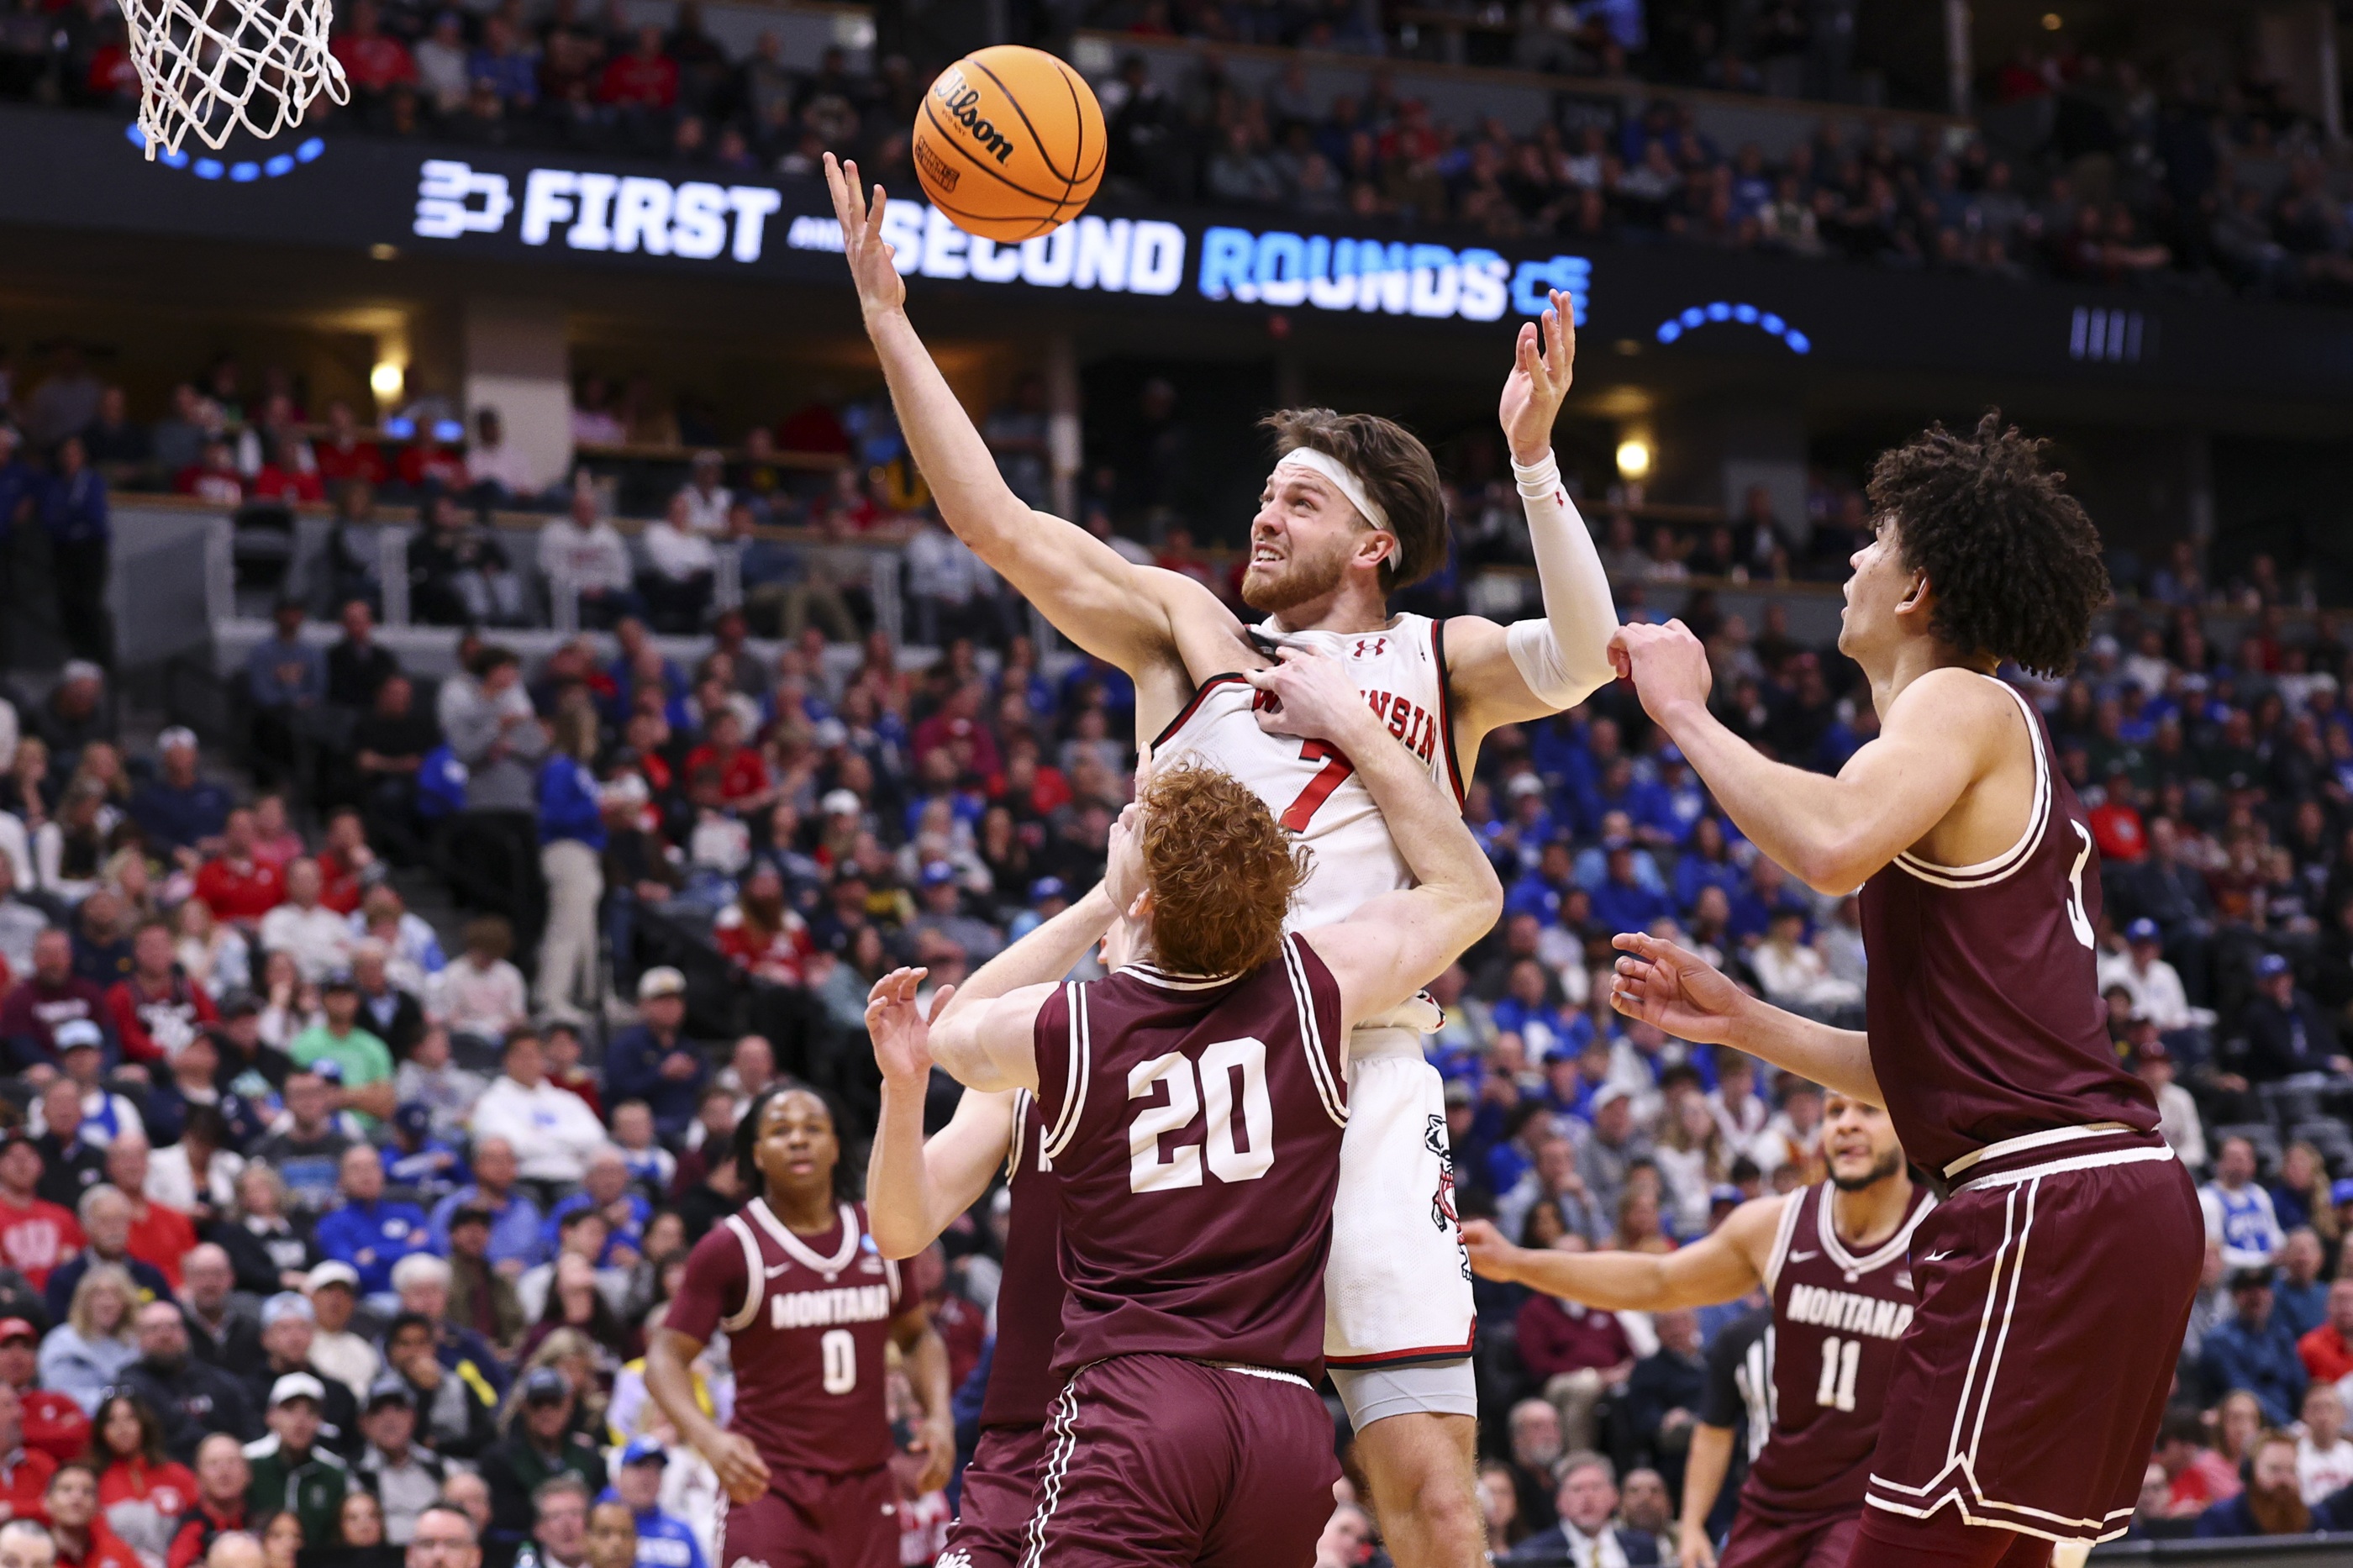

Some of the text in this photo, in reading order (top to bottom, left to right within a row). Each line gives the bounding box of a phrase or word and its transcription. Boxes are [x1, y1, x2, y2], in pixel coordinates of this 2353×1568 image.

[934, 67, 1013, 165] Wilson
[520, 168, 782, 263] FIRST
[879, 197, 1187, 296] SECOND
[1198, 226, 1510, 322] ROUNDS
[1278, 739, 1355, 834] 7
[1128, 1036, 1275, 1194] 20
[771, 1283, 890, 1329] MONTANA
[1786, 1282, 1915, 1340] MONTANA
[820, 1329, 856, 1394] 0
[1816, 1335, 1861, 1413] 11
